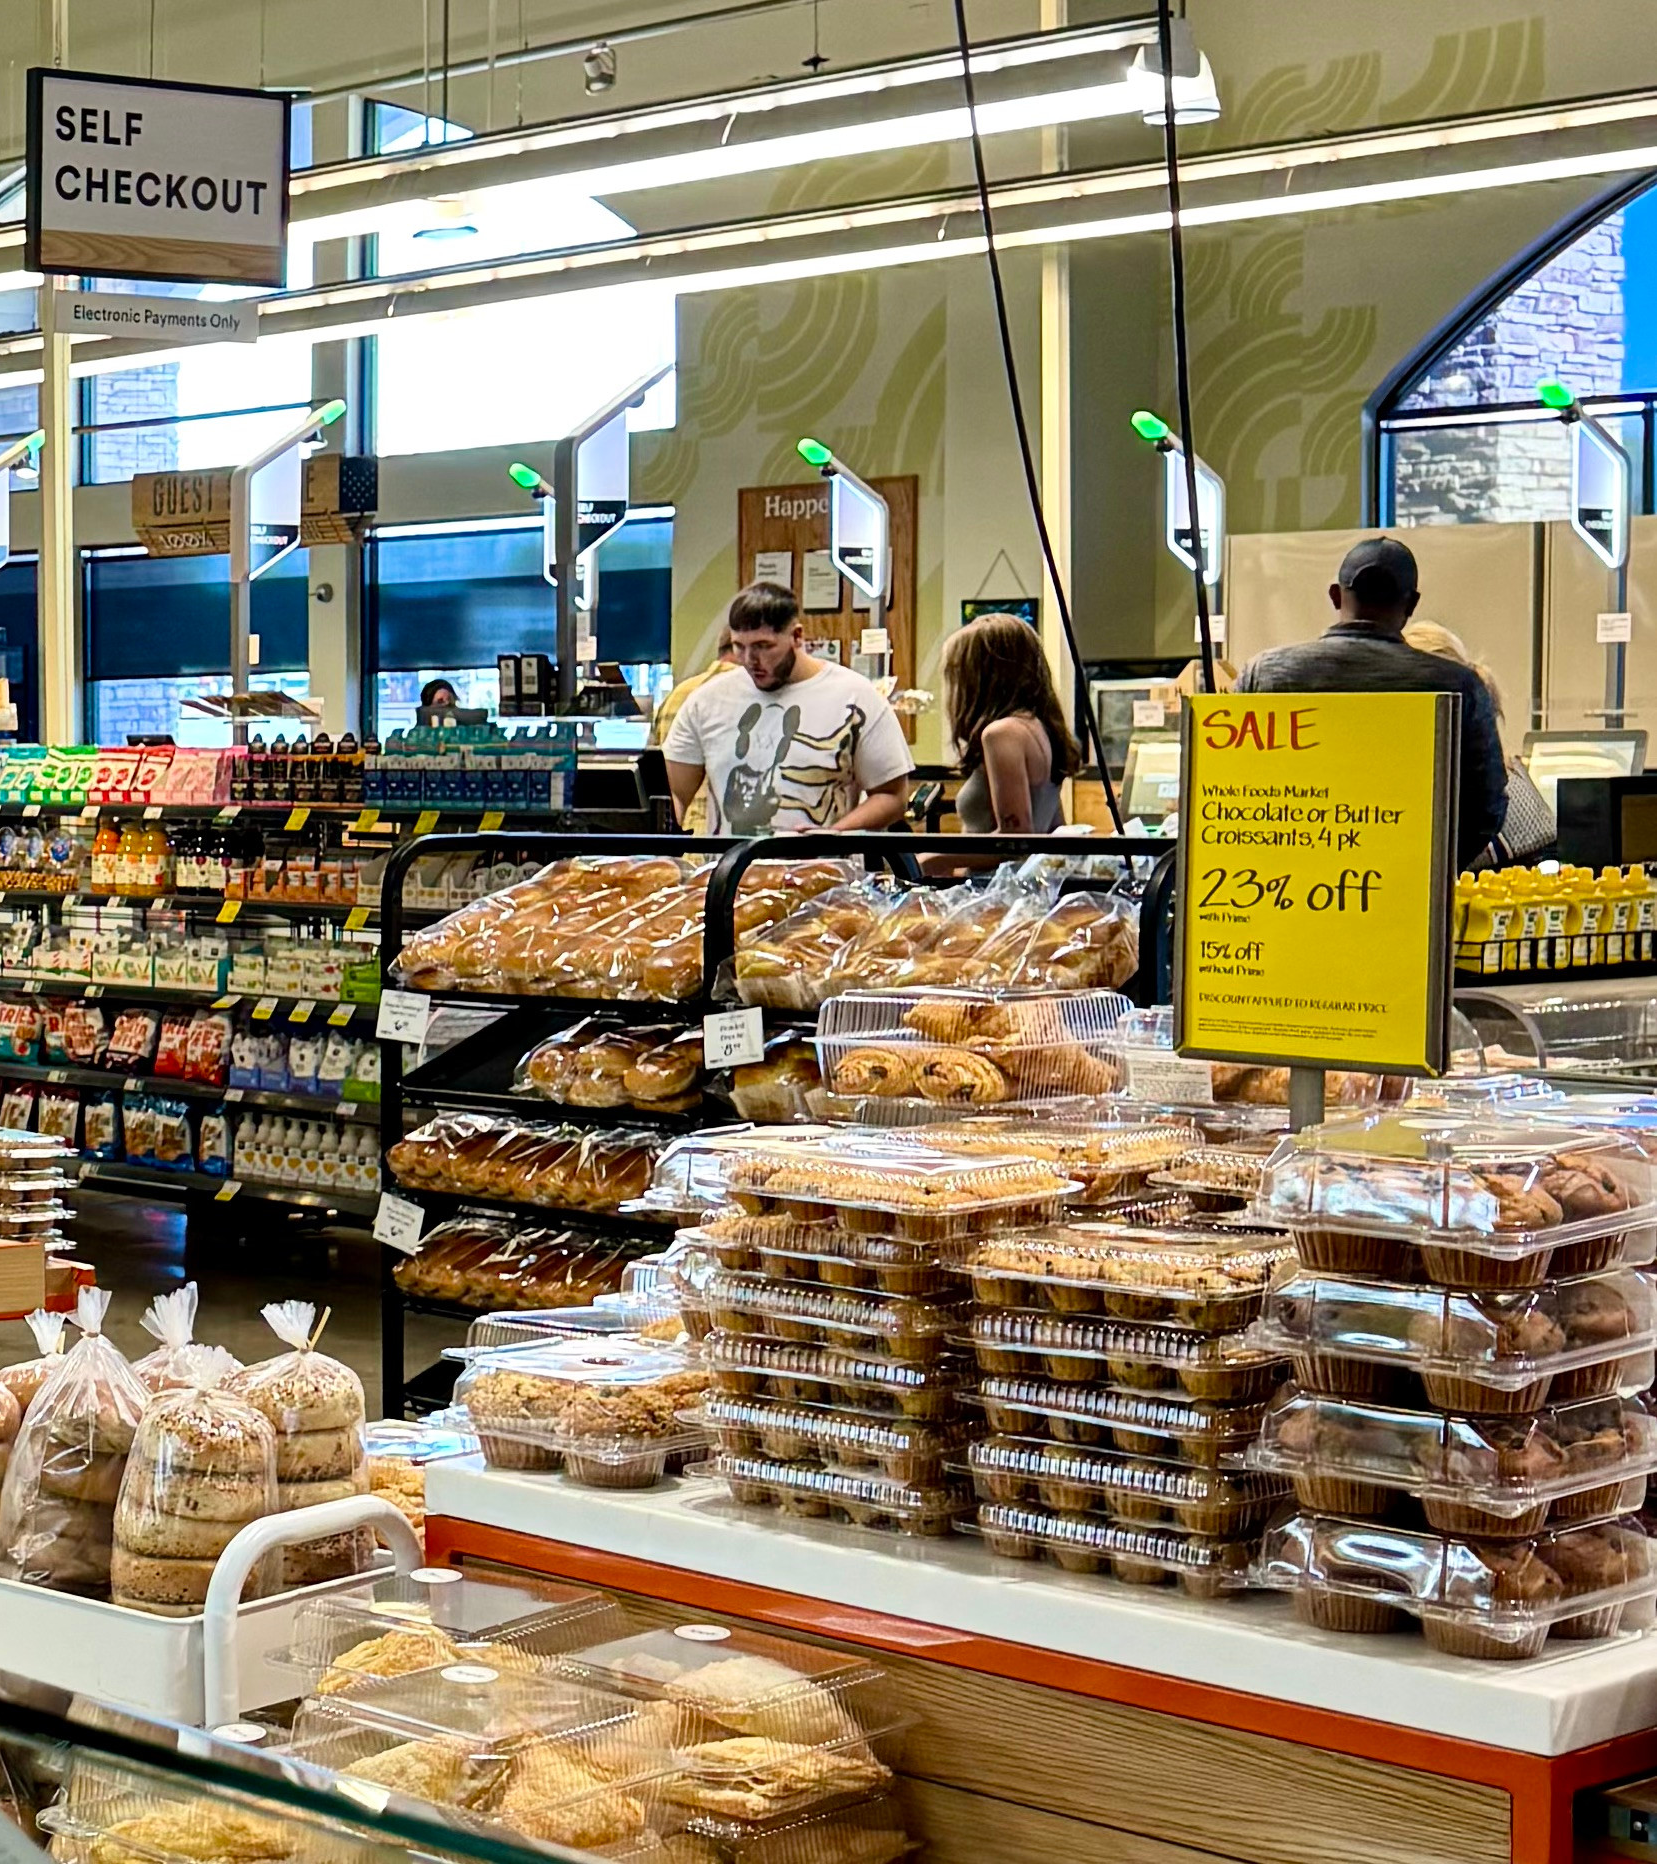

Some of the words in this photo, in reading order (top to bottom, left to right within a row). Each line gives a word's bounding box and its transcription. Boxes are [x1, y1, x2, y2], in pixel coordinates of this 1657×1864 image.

[56, 105, 143, 146] SELF
[55, 165, 267, 215] CHECKOUT
[73, 304, 141, 324] Electronic
[144, 308, 207, 328] Payments
[210, 314, 241, 332] Only
[153, 474, 213, 517] GUEST
[1202, 707, 1321, 752] SALE
[1202, 785, 1240, 799] Whole
[1242, 786, 1281, 799] Foods
[1284, 785, 1329, 799] Market
[1202, 801, 1304, 823] Chocolate
[1307, 807, 1330, 824] or
[1334, 804, 1405, 826] Butter
[1202, 826, 1315, 849] Croissants,
[1318, 827, 1332, 848] 4
[1337, 828, 1362, 852] pk
[1198, 867, 1294, 911] 23%
[1307, 868, 1383, 913] off
[1199, 912, 1220, 922] with
[1222, 912, 1250, 924] Prime
[1201, 940, 1231, 960] 15%
[1235, 941, 1265, 961] off
[1199, 963, 1234, 976] without
[1236, 965, 1264, 977] Prime
[1199, 992, 1250, 1005] DISCOUNT
[1252, 995, 1292, 1008] APPLIED
[1295, 997, 1308, 1009] TO
[1309, 998, 1355, 1012] REGULAR
[1358, 1001, 1389, 1014] PRICE
